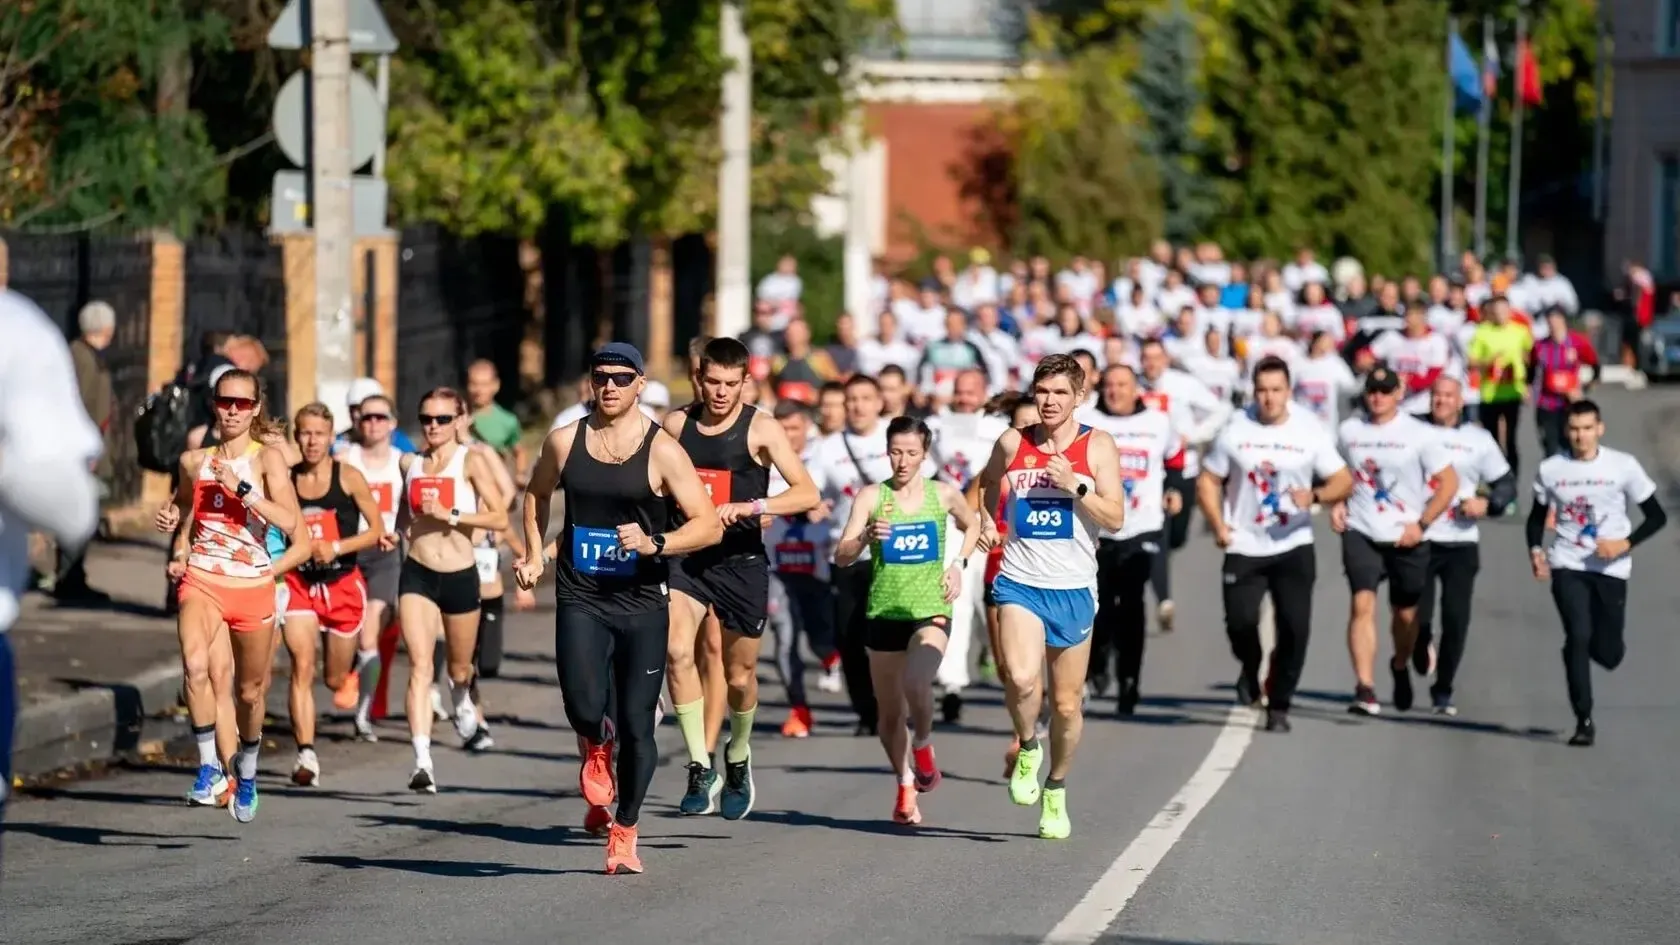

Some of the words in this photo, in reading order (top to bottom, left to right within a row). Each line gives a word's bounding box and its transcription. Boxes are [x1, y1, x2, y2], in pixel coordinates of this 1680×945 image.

[213, 493, 224, 508] 8
[1026, 510, 1062, 526] 493
[893, 533, 929, 551] 492
